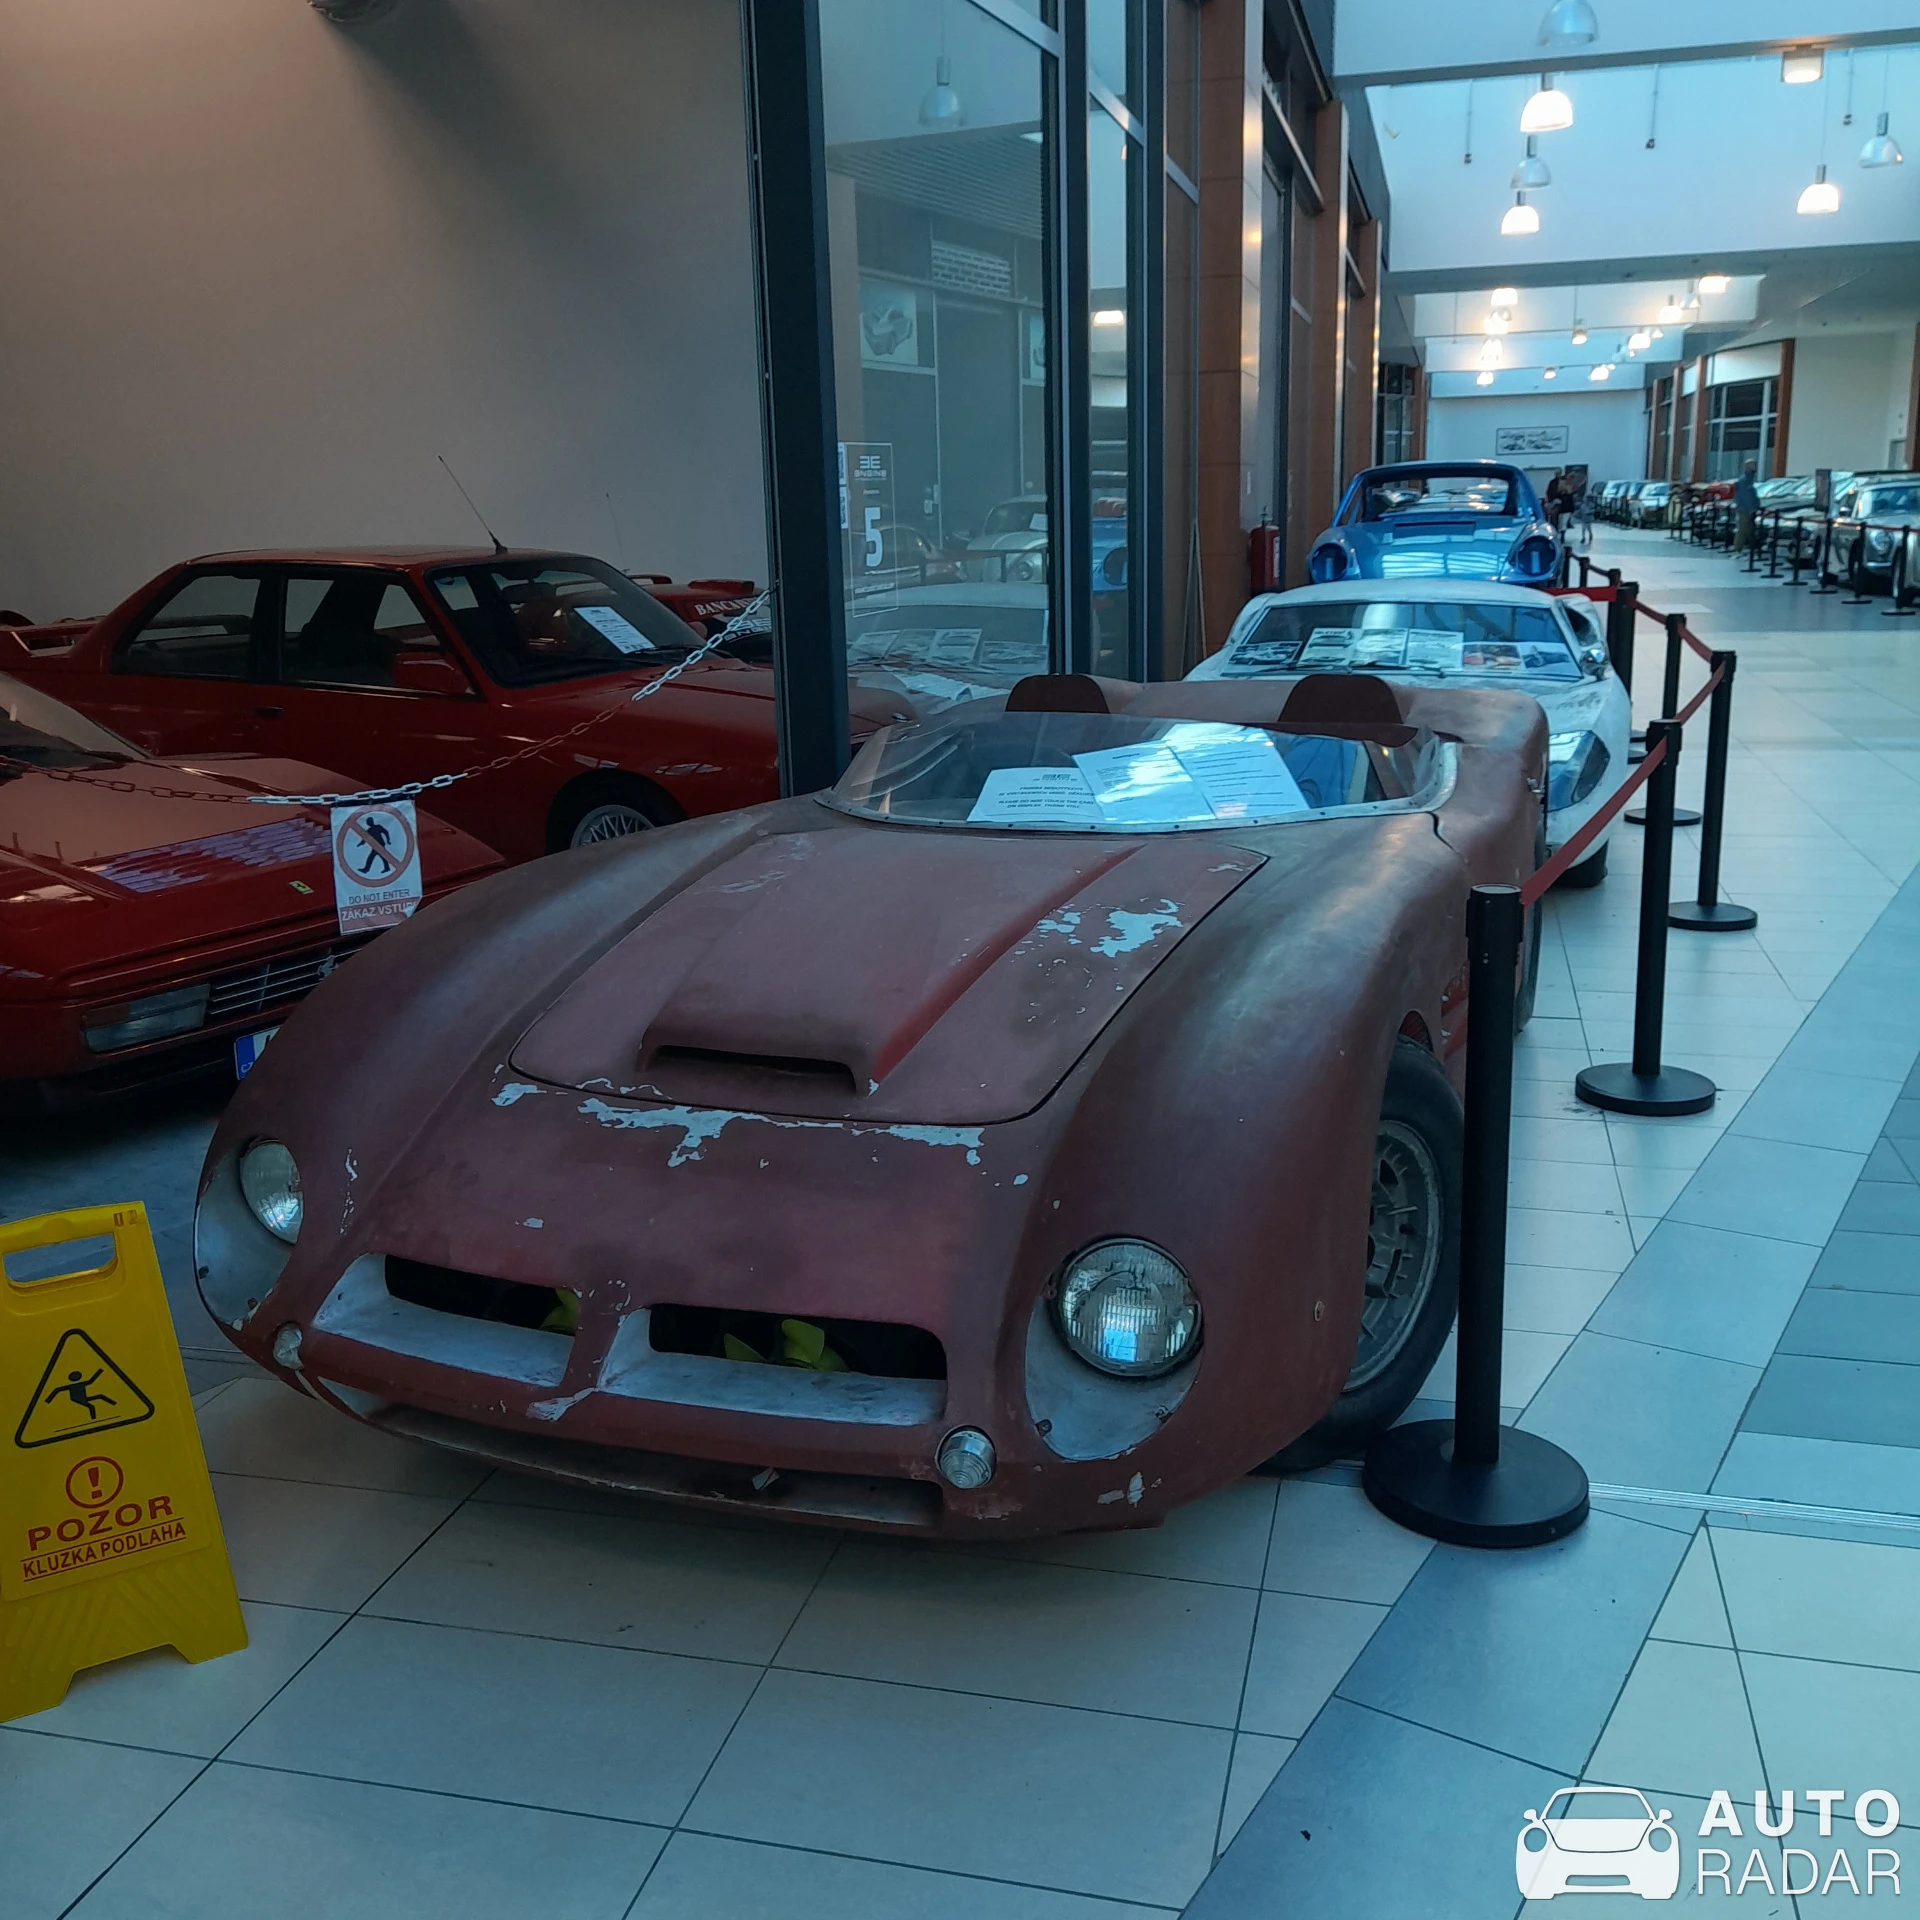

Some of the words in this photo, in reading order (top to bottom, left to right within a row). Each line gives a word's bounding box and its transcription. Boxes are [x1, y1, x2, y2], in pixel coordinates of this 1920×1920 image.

[864, 506, 884, 567] 5
[348, 896, 361, 905] DO
[363, 892, 380, 903] NOT
[383, 888, 411, 900] ENTER
[28, 1495, 173, 1552] POZOR
[100, 1521, 186, 1558] PODLAHA
